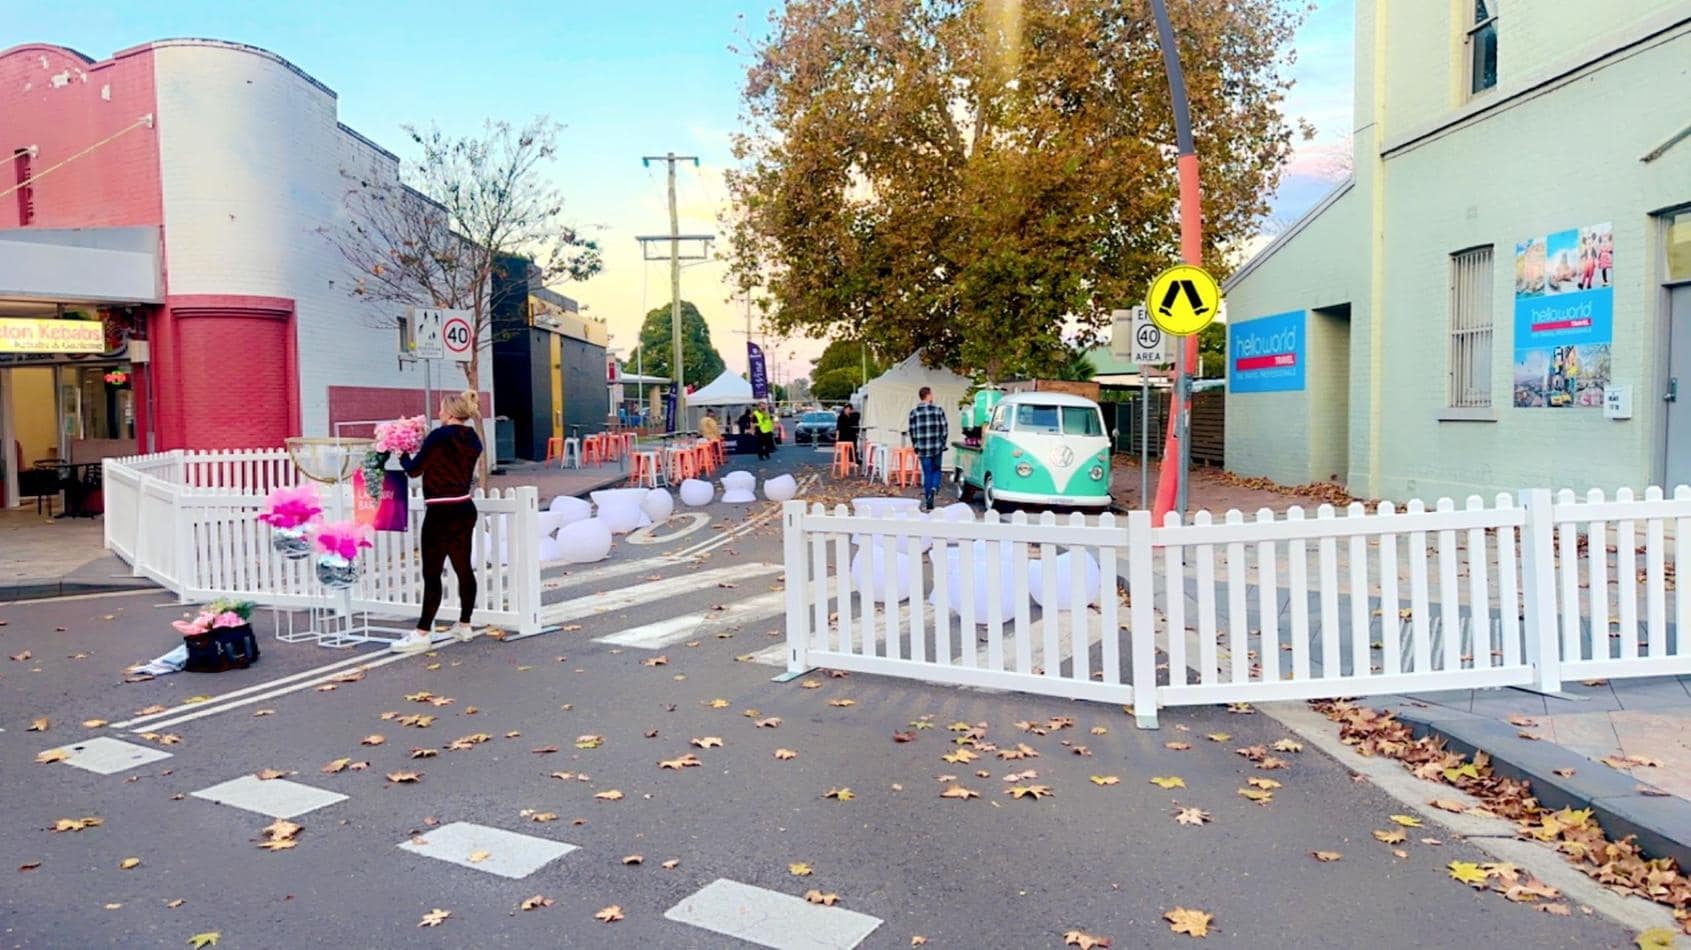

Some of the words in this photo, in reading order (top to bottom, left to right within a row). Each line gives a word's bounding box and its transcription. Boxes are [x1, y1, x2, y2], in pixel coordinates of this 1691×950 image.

[39, 322, 100, 341] Kebabs
[447, 327, 468, 344] 40
[1140, 329, 1157, 343] 40
[1236, 325, 1296, 357] helloworld
[1136, 353, 1160, 361] AREA
